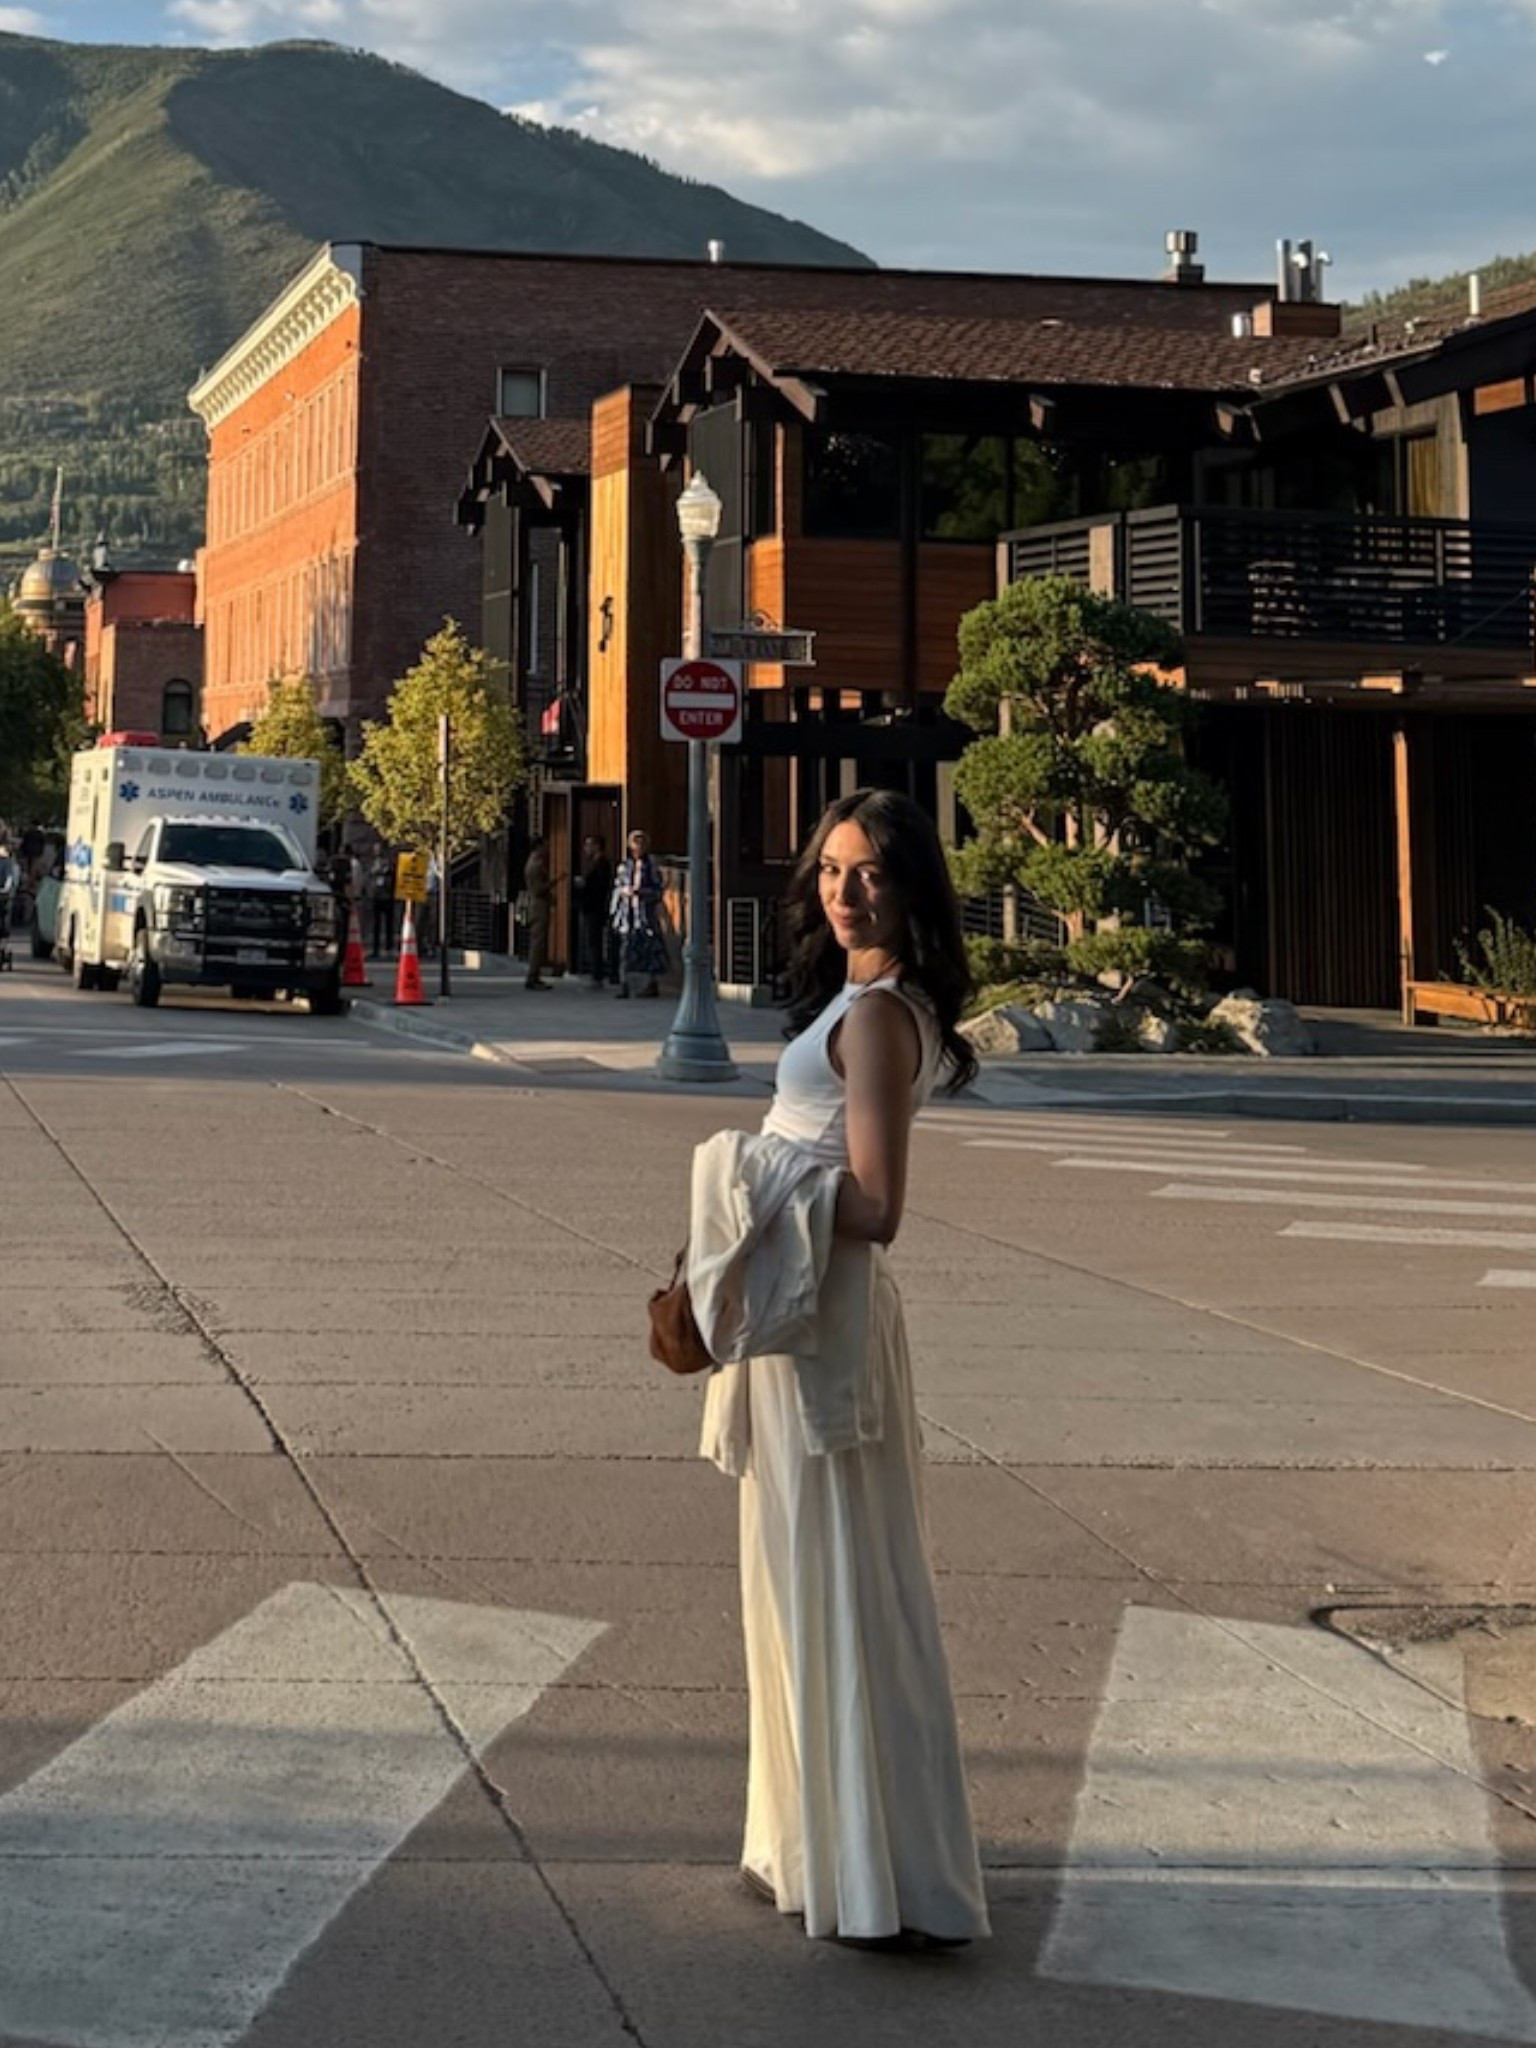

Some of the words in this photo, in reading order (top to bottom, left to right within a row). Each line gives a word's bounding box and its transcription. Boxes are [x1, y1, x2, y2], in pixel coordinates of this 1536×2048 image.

[673, 674, 694, 689] DO
[700, 676, 728, 690] NOT
[679, 711, 723, 726] ENTER
[147, 787, 195, 802] ASPEN
